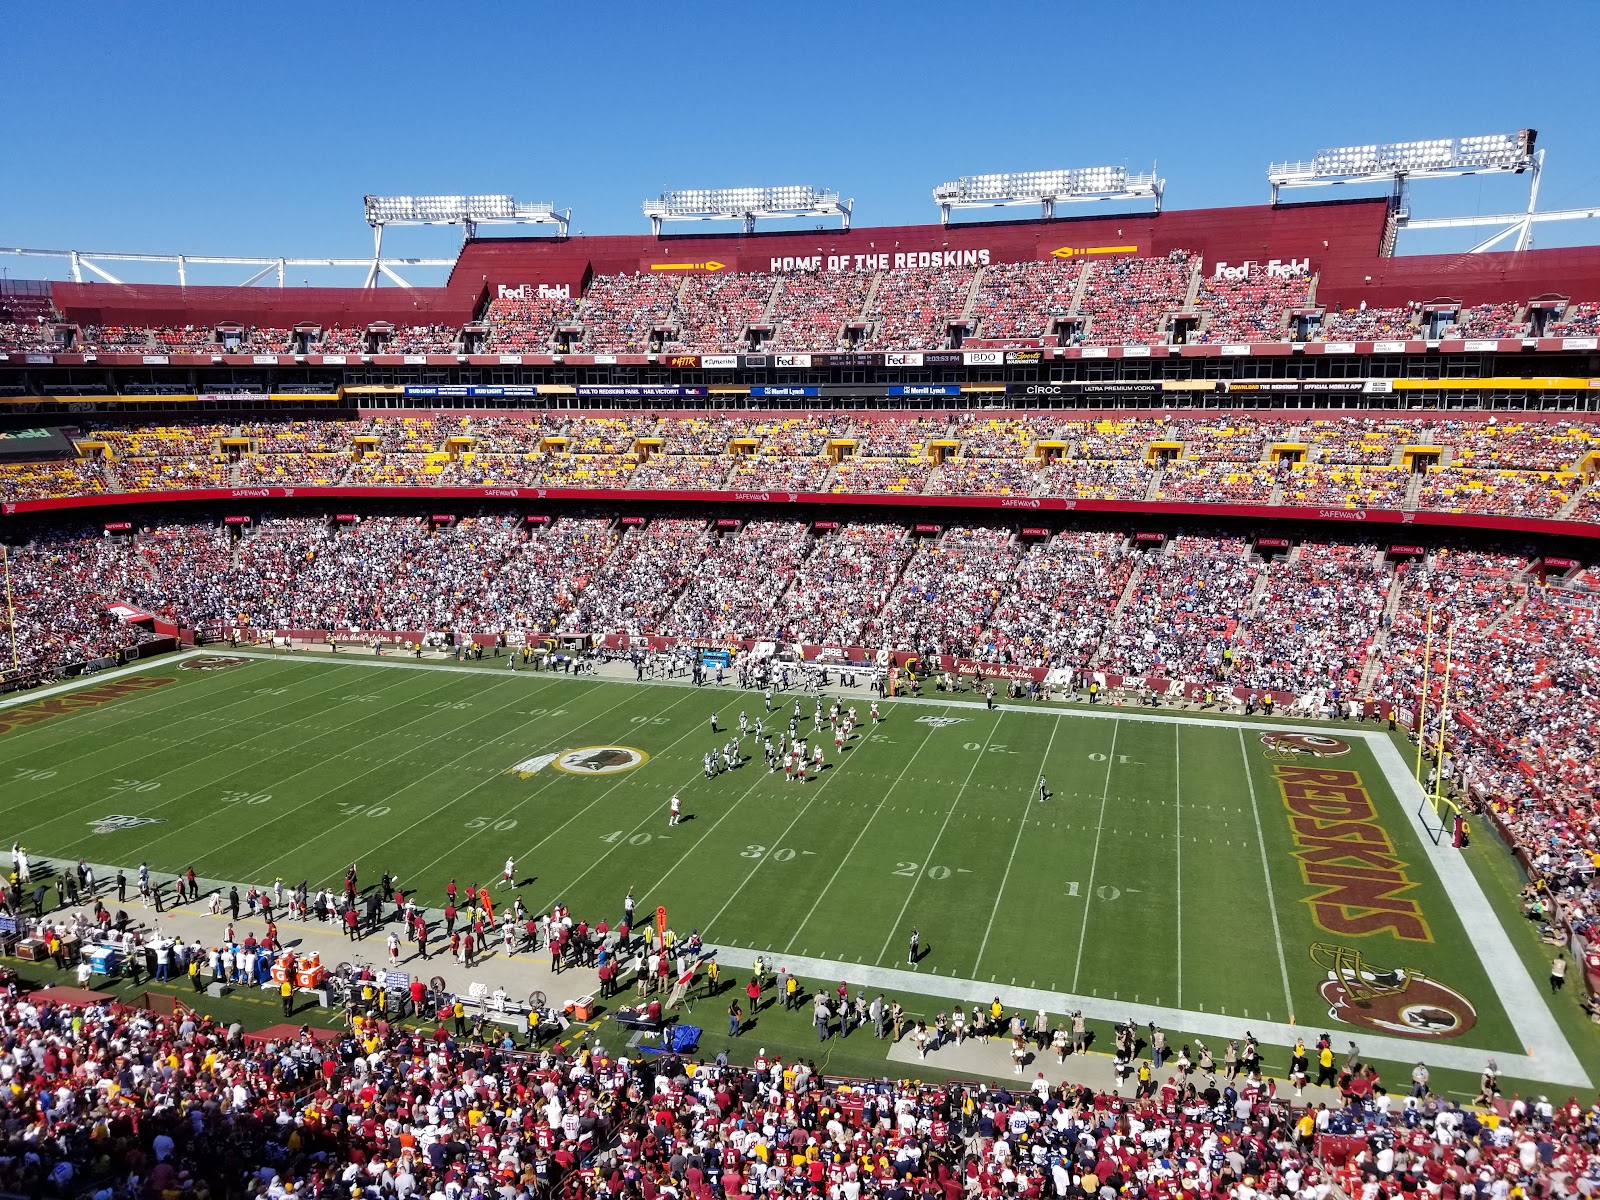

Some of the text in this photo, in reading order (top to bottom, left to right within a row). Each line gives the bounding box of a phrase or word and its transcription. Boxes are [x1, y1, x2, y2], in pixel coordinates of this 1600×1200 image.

[770, 249, 990, 272] HOME OF THE REDSKINS
[1215, 258, 1310, 279] FedExField
[497, 284, 570, 299] FedExField
[776, 356, 806, 366] FedEx
[887, 354, 917, 365] FedEx
[974, 352, 996, 362] BDO
[788, 387, 805, 396] Lynch
[911, 386, 946, 396] Merrill Lynch
[1304, 383, 1328, 391] OFFICIAL
[232, 489, 262, 497] SAFEWAY
[485, 489, 512, 497] SAFEWAY
[1001, 499, 1033, 507] SAFEWAY
[1319, 510, 1357, 519] SAFEWAY
[1544, 558, 1569, 566] SAFEWAY
[699, 639, 710, 647] the
[822, 647, 842, 656] 1982
[958, 663, 975, 673] Hail
[985, 667, 997, 676] the
[1122, 675, 1146, 687] 1987
[630, 715, 671, 725] 50
[963, 741, 1008, 753] 20
[1088, 752, 1131, 764] 10
[109, 779, 162, 793] 20
[220, 790, 273, 805] 30
[338, 803, 392, 818] 40
[464, 816, 518, 832] 50
[599, 829, 652, 846] 40
[740, 843, 797, 862] 30
[1269, 764, 1435, 943] REDSKINS
[892, 861, 952, 880] 20
[1064, 880, 1121, 900] 10
[276, 970, 285, 981] G
[299, 975, 309, 985] G
[1037, 1084, 1047, 1094] 21
[1248, 1094, 1257, 1104] 17
[566, 1122, 576, 1131] 91
[1014, 1120, 1026, 1129] 82
[538, 1136, 548, 1147] 81
[735, 1137, 744, 1147] 17
[726, 1155, 735, 1164] 11
[584, 1176, 591, 1187] 9
[710, 1175, 717, 1185] 4
